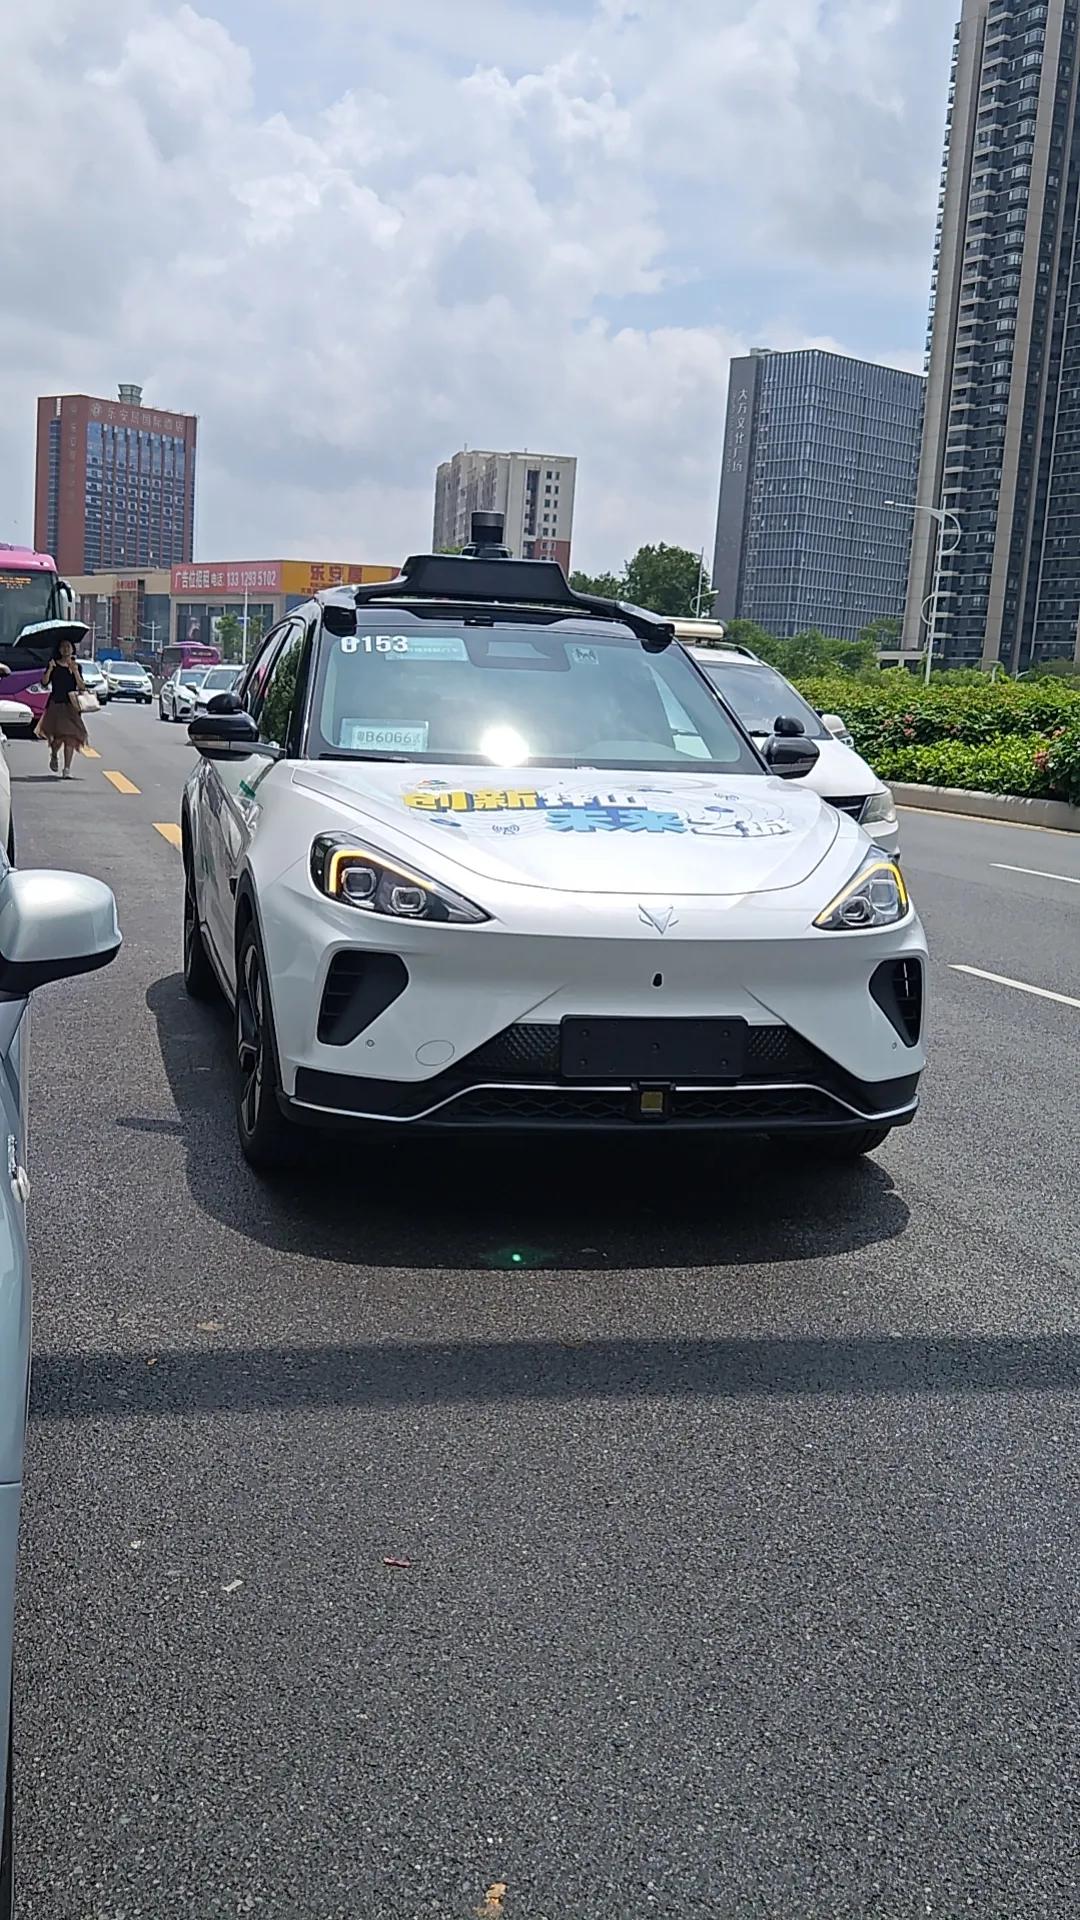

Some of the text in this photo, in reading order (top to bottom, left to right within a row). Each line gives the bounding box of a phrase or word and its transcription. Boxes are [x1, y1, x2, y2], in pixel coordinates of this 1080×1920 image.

[731, 388, 748, 472] 大万文化广场
[175, 570, 210, 589] 广告位招租
[227, 571, 239, 587] 133
[241, 571, 257, 587] 1293
[257, 570, 277, 586] 5102
[340, 635, 409, 653] 0153
[403, 788, 649, 812] 创新坪山
